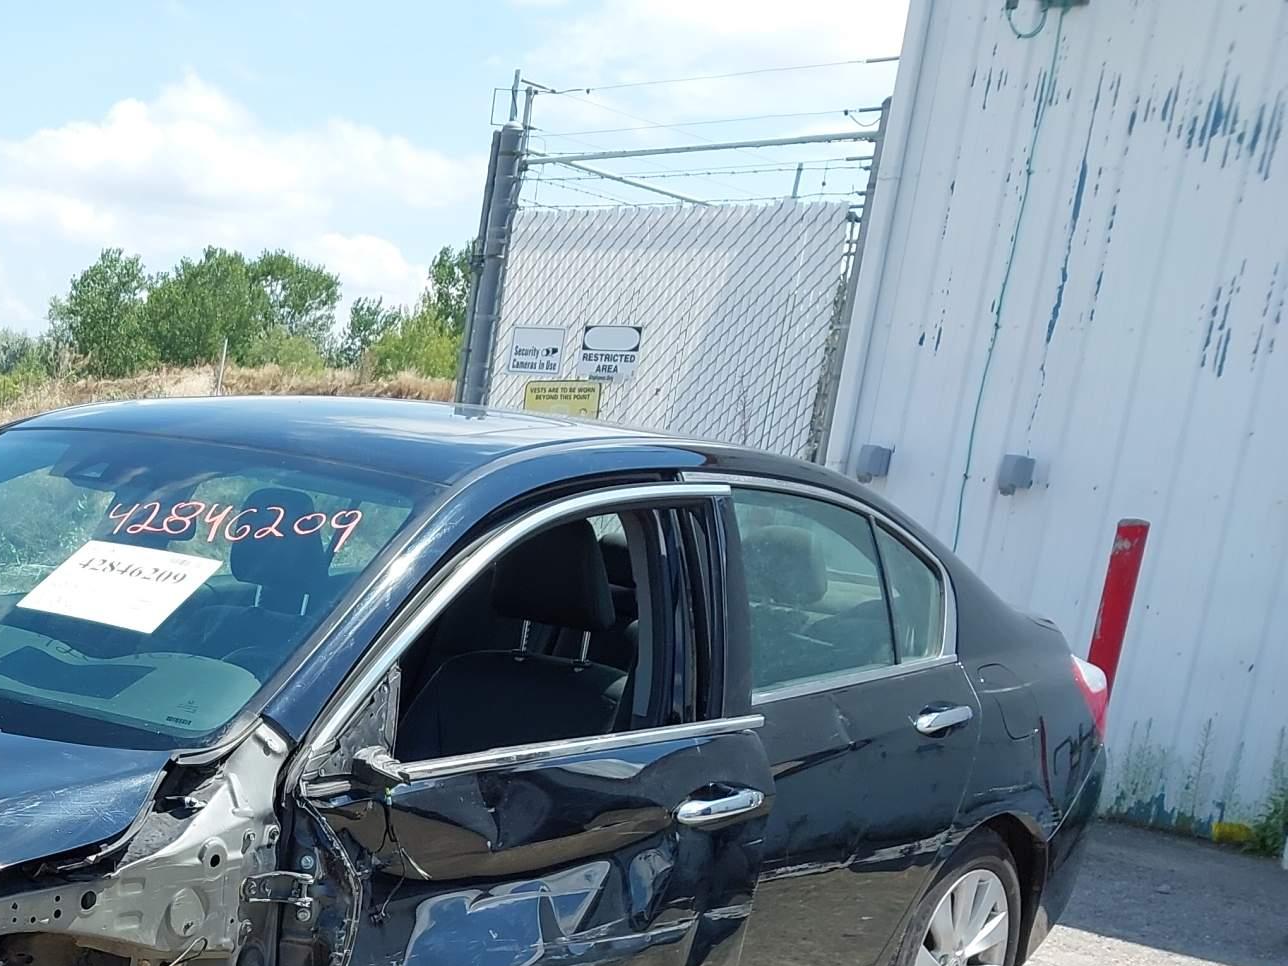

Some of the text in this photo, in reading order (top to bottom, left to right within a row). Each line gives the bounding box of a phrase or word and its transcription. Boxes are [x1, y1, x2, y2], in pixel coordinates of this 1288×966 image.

[514, 345, 539, 358] Security
[582, 353, 635, 363] RESTRICTED
[512, 359, 537, 369] Cameras
[545, 360, 557, 370] Use
[595, 364, 618, 373] AREA
[108, 501, 362, 553] 42846209
[79, 557, 187, 584] 42846209
